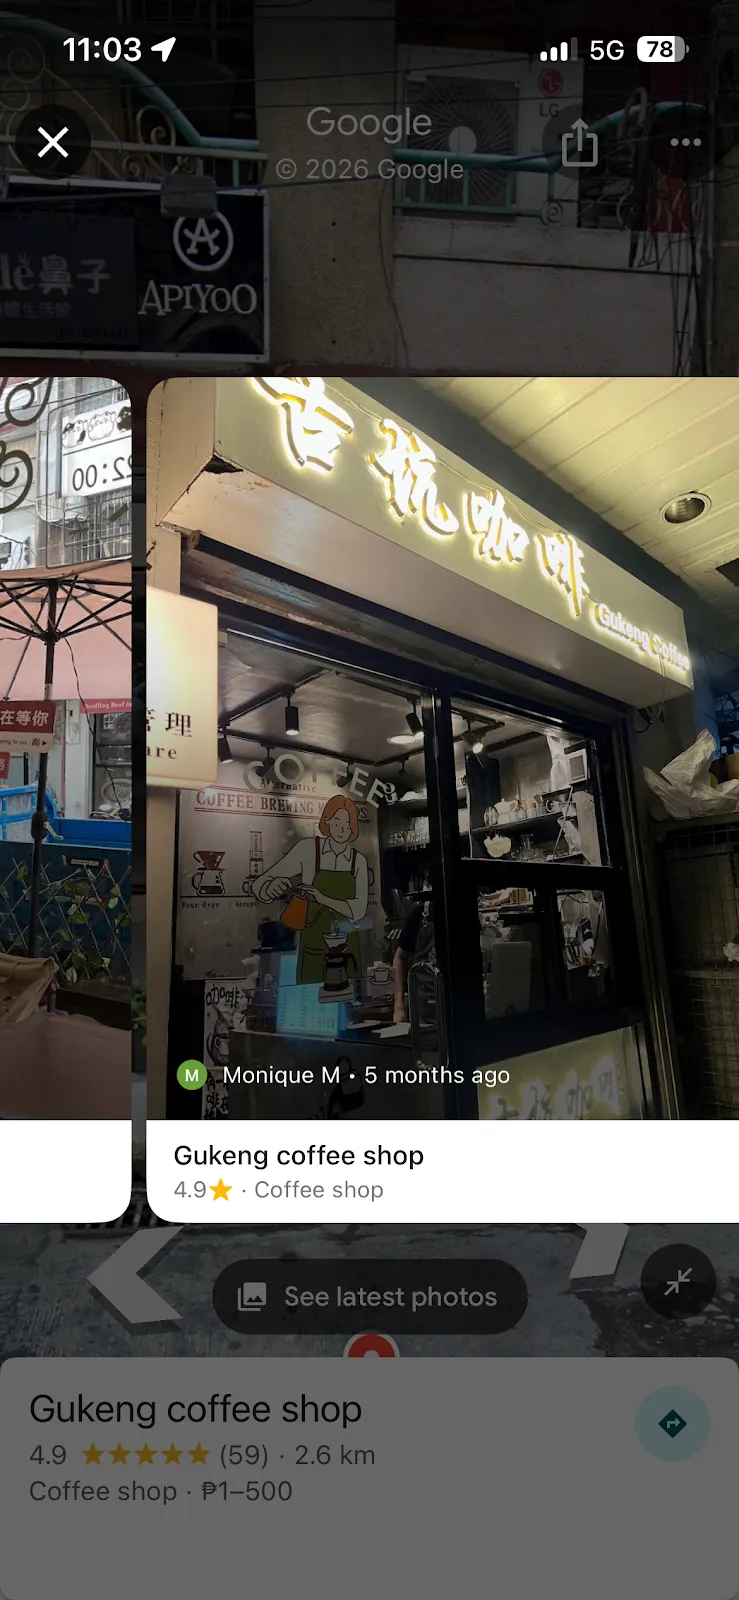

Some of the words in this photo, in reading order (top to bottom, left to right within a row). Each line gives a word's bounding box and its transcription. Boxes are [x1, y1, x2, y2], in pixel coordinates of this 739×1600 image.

[540, 103, 559, 117] LG
[38, 253, 112, 296] 鼻子
[594, 602, 649, 648] Gukeng
[648, 630, 691, 671] Coffee
[0, 709, 49, 727] 在等你
[243, 753, 385, 809] COFFEE
[260, 777, 317, 793] Aernative
[196, 791, 254, 809] COFFEE
[261, 797, 314, 814] BREWING
[182, 901, 198, 909] Pour
